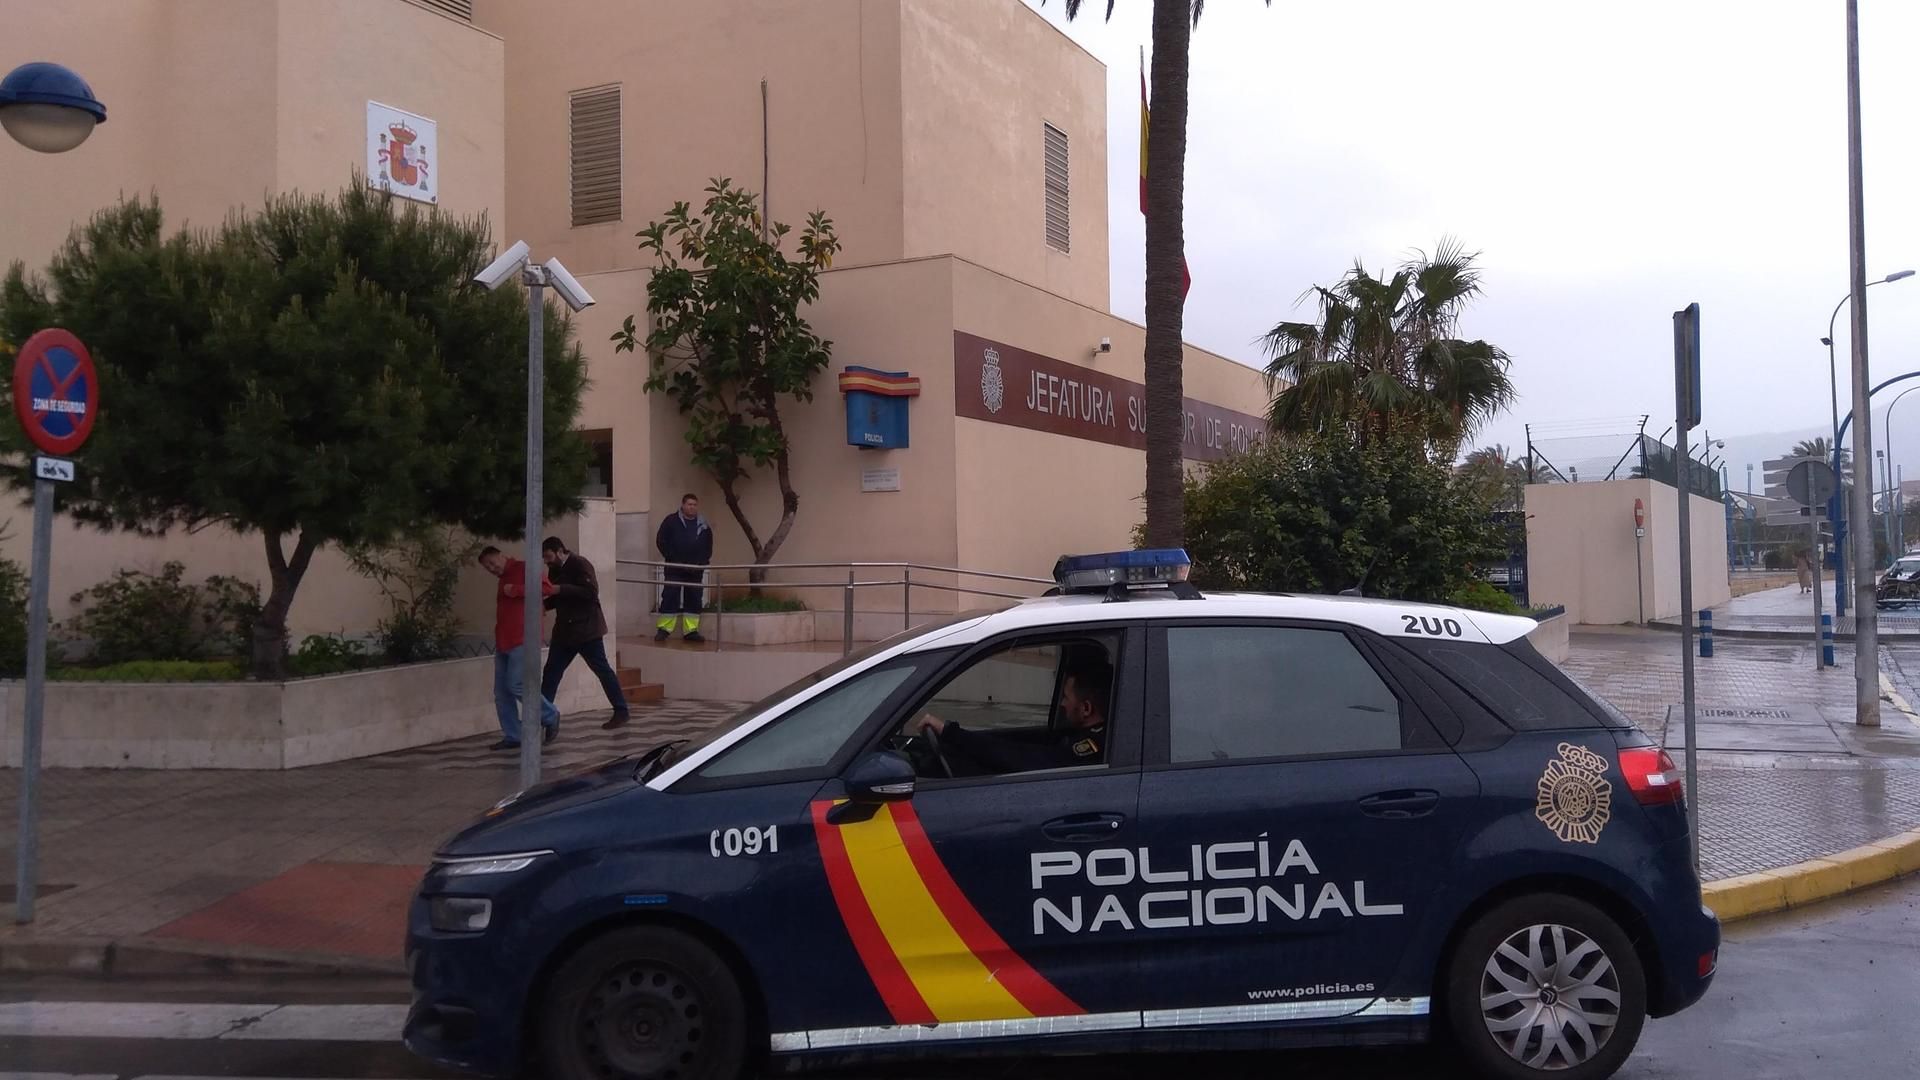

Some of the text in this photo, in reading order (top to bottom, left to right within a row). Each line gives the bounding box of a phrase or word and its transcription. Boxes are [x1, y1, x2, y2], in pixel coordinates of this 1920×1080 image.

[33, 397, 86, 414] ZONA DE SEGURIDAD
[1027, 369, 1116, 428] JEFATURA
[1128, 395, 1196, 446] SUOR
[1206, 416, 1222, 450] DE
[723, 824, 778, 857] 091
[1030, 831, 1320, 890] POLICÍA
[1033, 880, 1404, 936] NACIONAL
[1247, 982, 1376, 1000] www.policia.es
